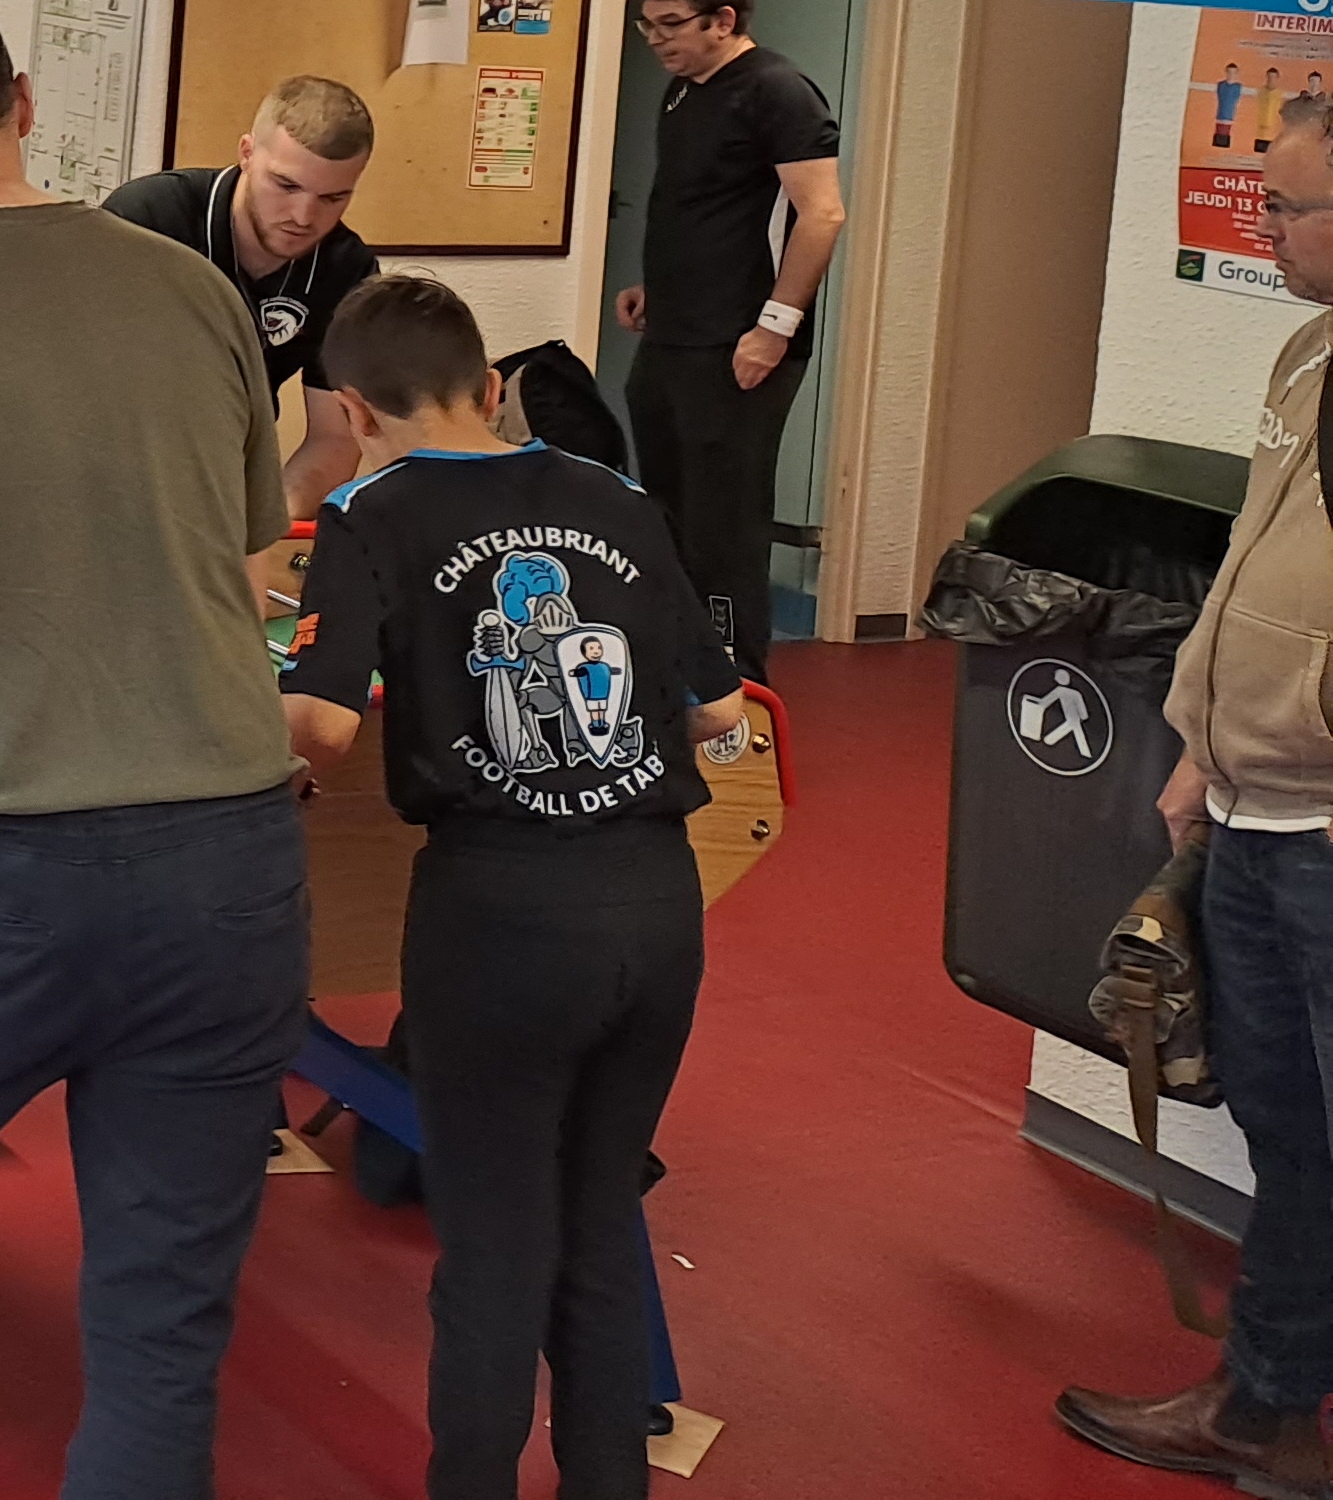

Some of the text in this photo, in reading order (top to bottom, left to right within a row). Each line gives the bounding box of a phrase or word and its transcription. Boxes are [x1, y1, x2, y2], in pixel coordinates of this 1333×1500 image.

[1184, 190, 1232, 209] JEUDI
[1236, 197, 1253, 212] 13
[434, 526, 640, 594] CHÂTEAUBRIANT
[450, 735, 574, 816] FOOTBALL
[579, 784, 619, 814] DE
